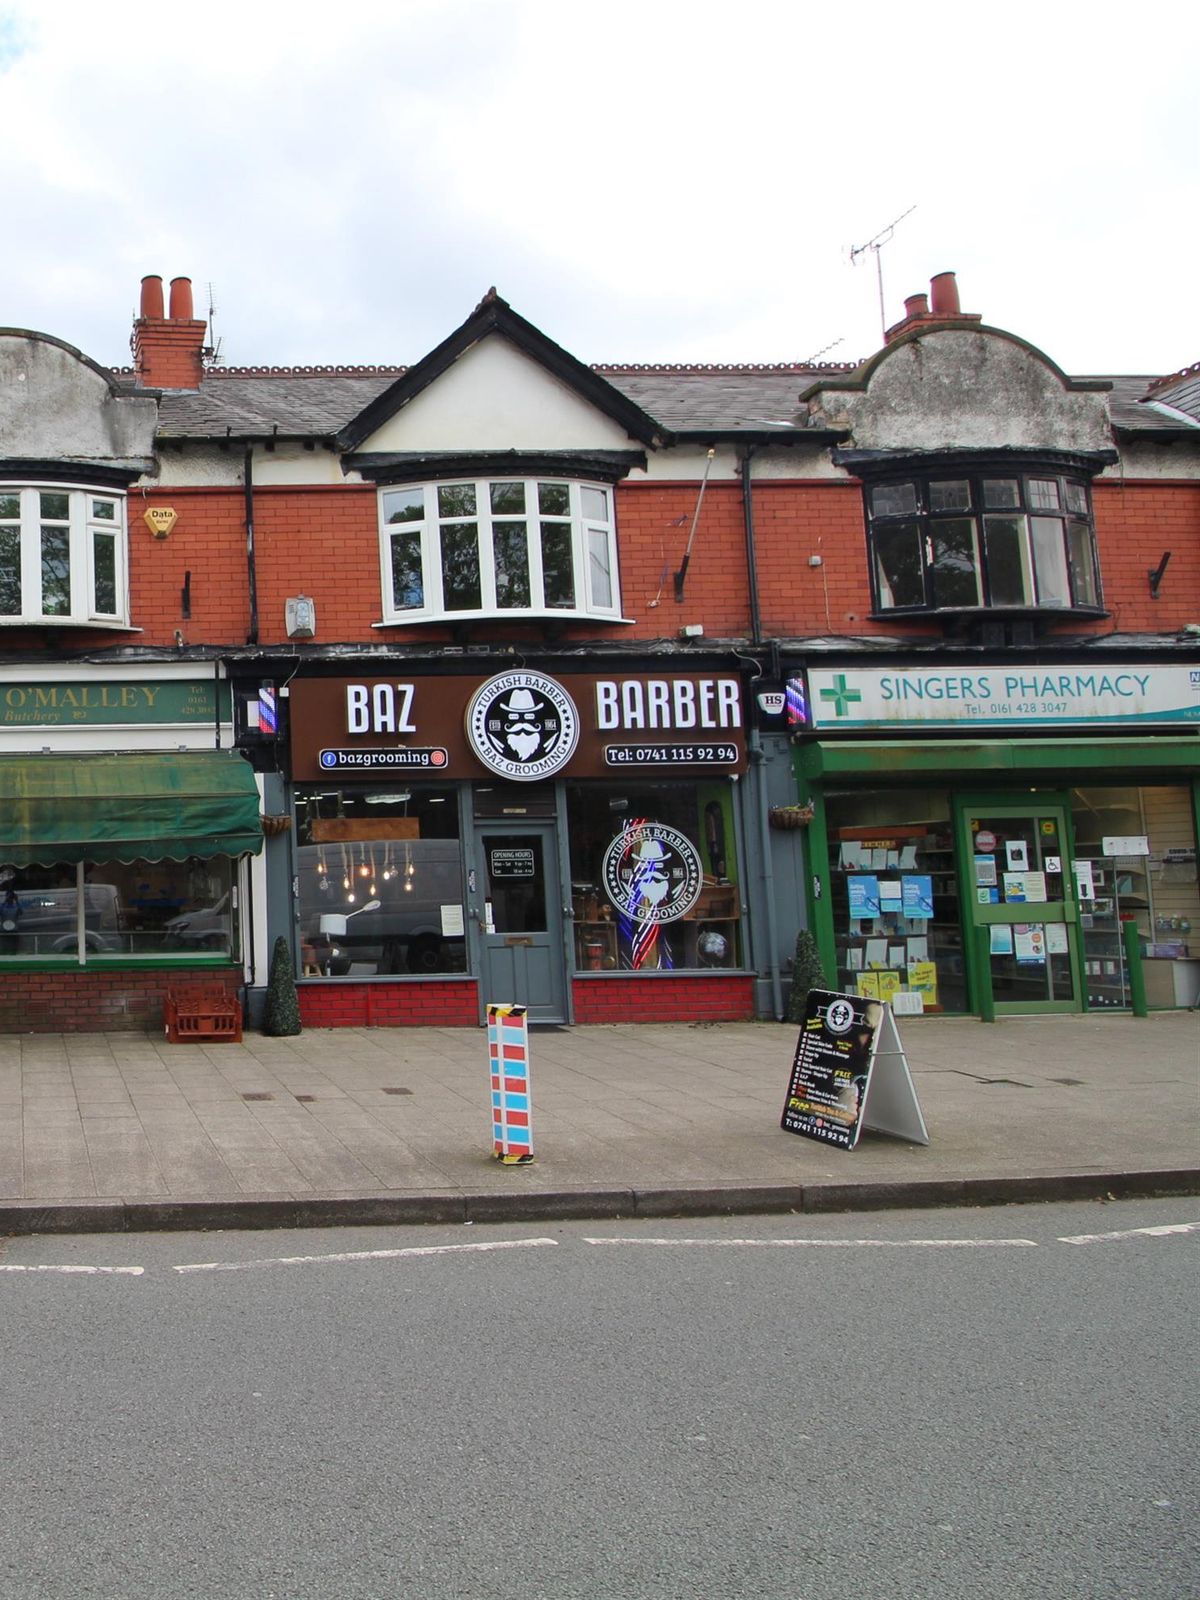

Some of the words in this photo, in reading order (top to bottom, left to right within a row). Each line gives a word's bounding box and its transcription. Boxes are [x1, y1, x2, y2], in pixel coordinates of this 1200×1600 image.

[6, 686, 160, 708] O'MALLEY
[478, 676, 521, 708] TURKISH
[525, 676, 566, 708] BARBER
[880, 677, 991, 700] SINGERS
[1005, 675, 1150, 698] PHARMACY
[347, 684, 416, 733] BAZ
[596, 680, 741, 729] BARBER
[765, 696, 782, 704] HS
[965, 704, 984, 714] Tel.
[991, 704, 1012, 714] 0161
[1016, 703, 1036, 713] 428
[1041, 702, 1067, 712] 3047
[5, 710, 61, 722] Butchery
[339, 752, 429, 765] bazgrooming
[484, 747, 504, 768] BAZ
[506, 746, 566, 774] GROOMING
[609, 750, 633, 761] Tel:
[636, 750, 667, 760] 0741
[671, 749, 693, 760] 115
[698, 748, 714, 759] 92
[718, 748, 734, 759] 94
[610, 828, 651, 859] TURKISH
[654, 828, 691, 858] BARBER
[788, 1098, 809, 1110] Free
[786, 1118, 792, 1126] T:
[793, 1121, 811, 1132] 0741
[813, 1127, 826, 1137] 115
[828, 1131, 837, 1140] 92
[839, 1134, 848, 1144] 94
